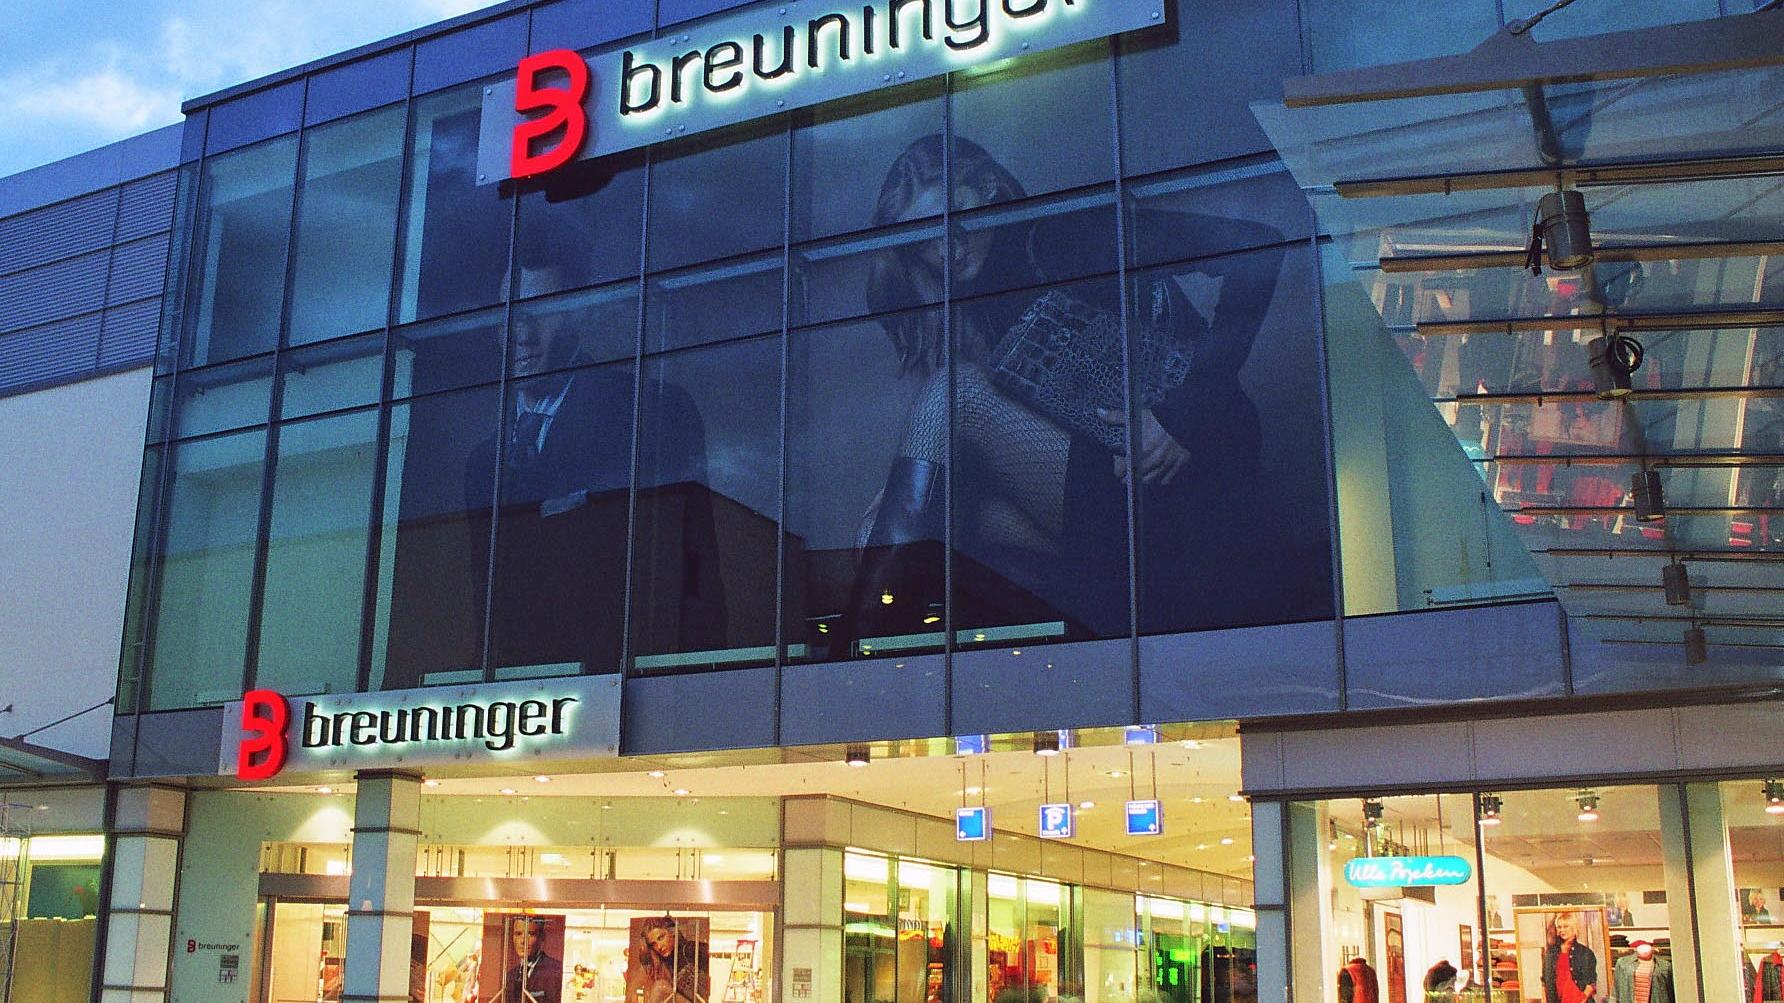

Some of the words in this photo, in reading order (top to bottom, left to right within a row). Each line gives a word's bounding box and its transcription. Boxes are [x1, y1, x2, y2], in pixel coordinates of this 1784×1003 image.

[619, 0, 1075, 116] breuning
[301, 697, 579, 751] breuninger
[1349, 860, 1385, 881] Ulla
[198, 942, 240, 952] breuninger
